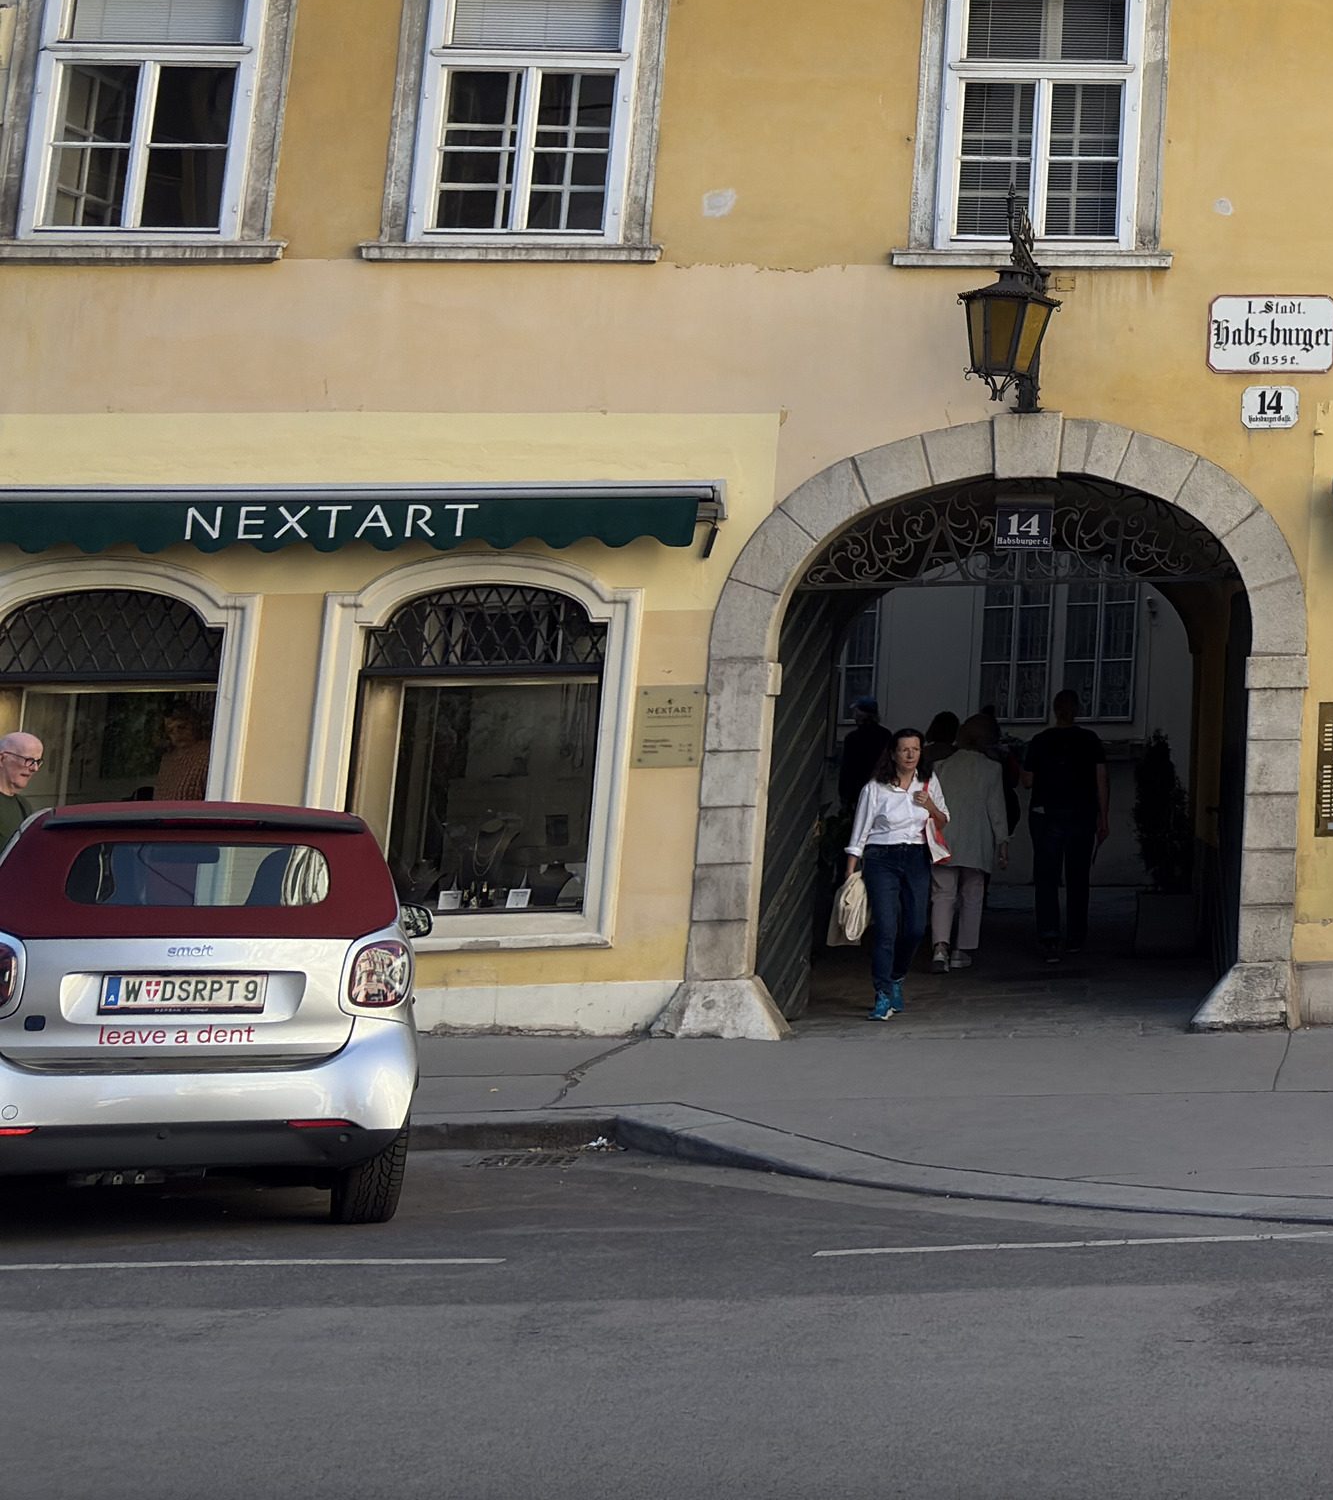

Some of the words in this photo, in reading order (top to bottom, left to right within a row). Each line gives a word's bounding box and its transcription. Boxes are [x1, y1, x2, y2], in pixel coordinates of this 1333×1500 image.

[1211, 317, 1333, 353] Habsburger
[1257, 389, 1284, 415] 14
[184, 504, 480, 540] NEXTART
[1007, 513, 1041, 536] 14
[646, 706, 693, 715] NEXTART
[125, 979, 144, 1003] W
[160, 979, 240, 1002] DSRPT
[243, 979, 259, 1002] 9
[99, 1025, 167, 1045] leave
[174, 1030, 189, 1044] a
[196, 1024, 256, 1044] dent
